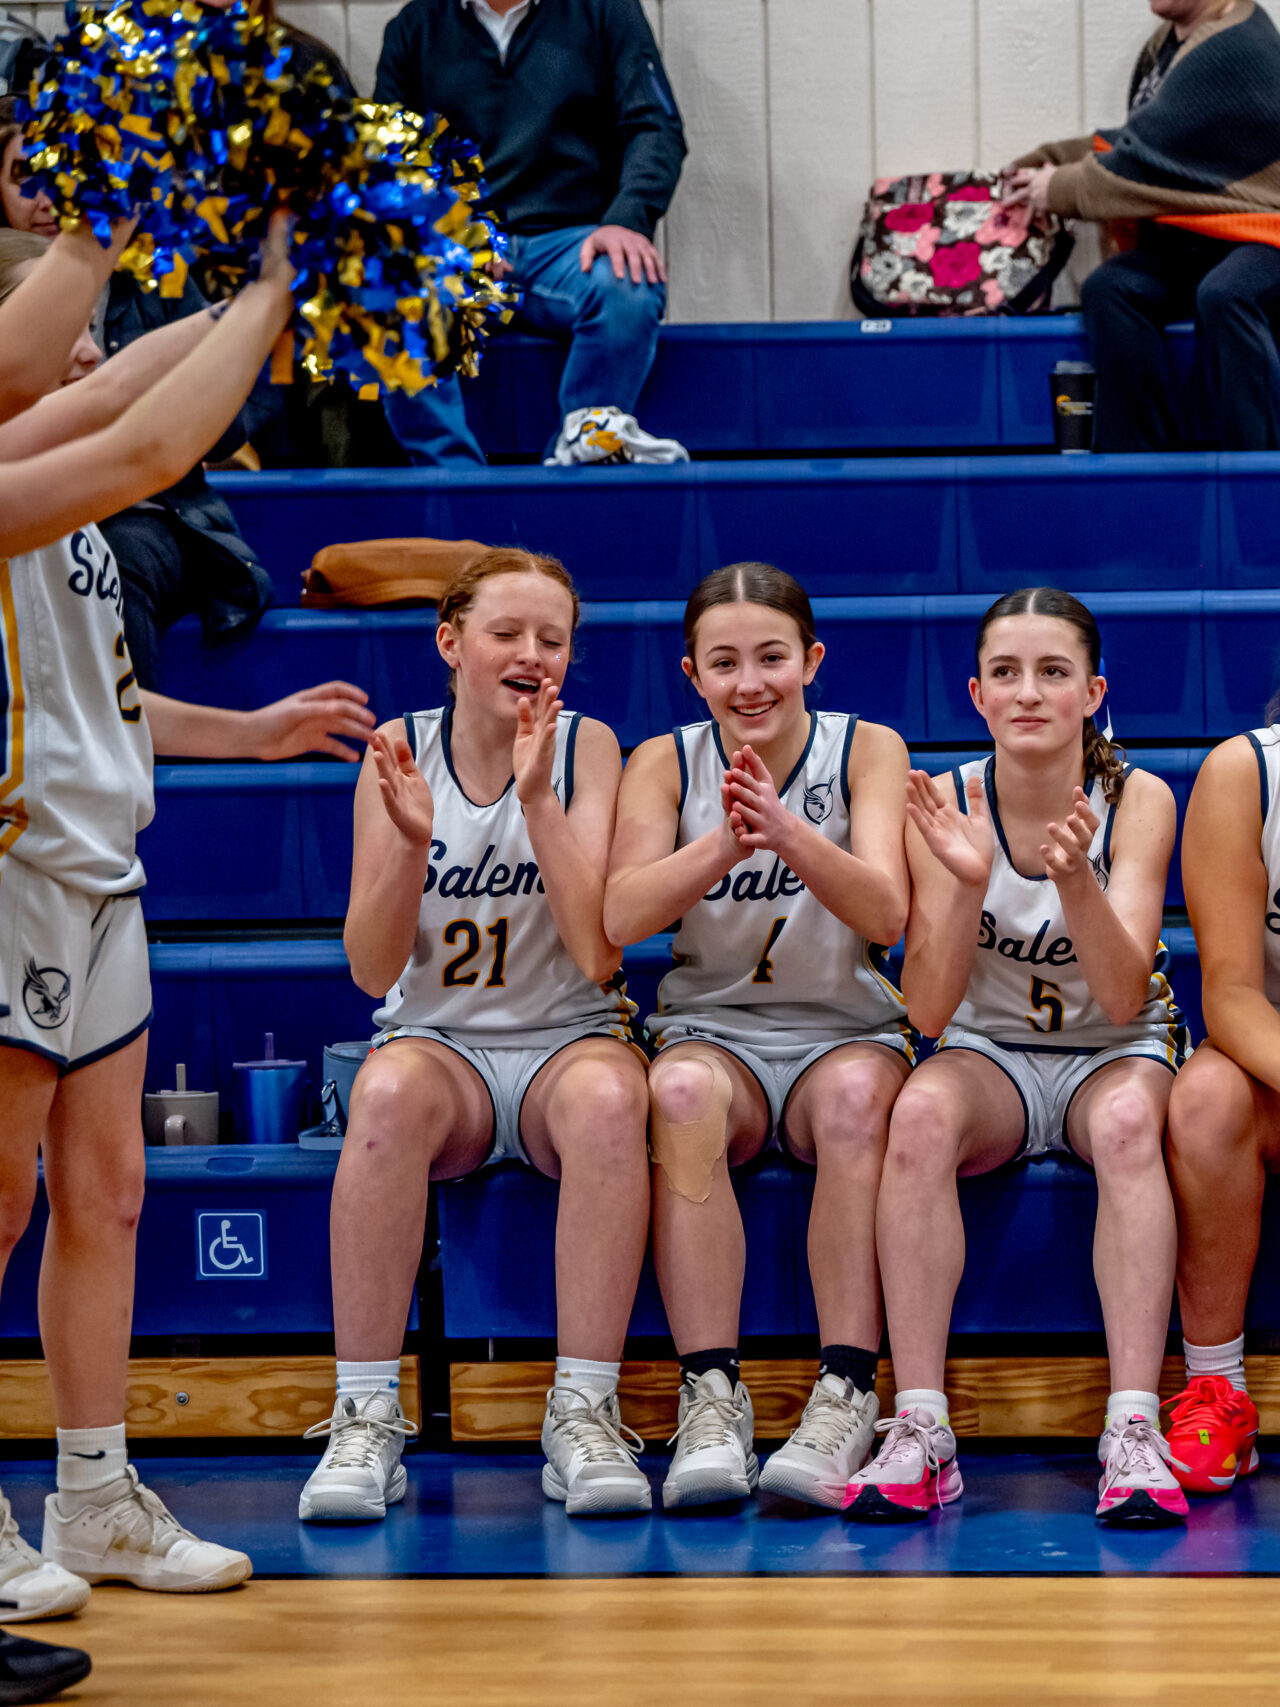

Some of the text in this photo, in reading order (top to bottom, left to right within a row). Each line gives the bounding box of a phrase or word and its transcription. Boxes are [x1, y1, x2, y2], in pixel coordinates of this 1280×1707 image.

[702, 855, 806, 902] ale
[441, 916, 509, 988] 21
[977, 910, 1078, 966] Sale
[1025, 974, 1064, 1034] 5
